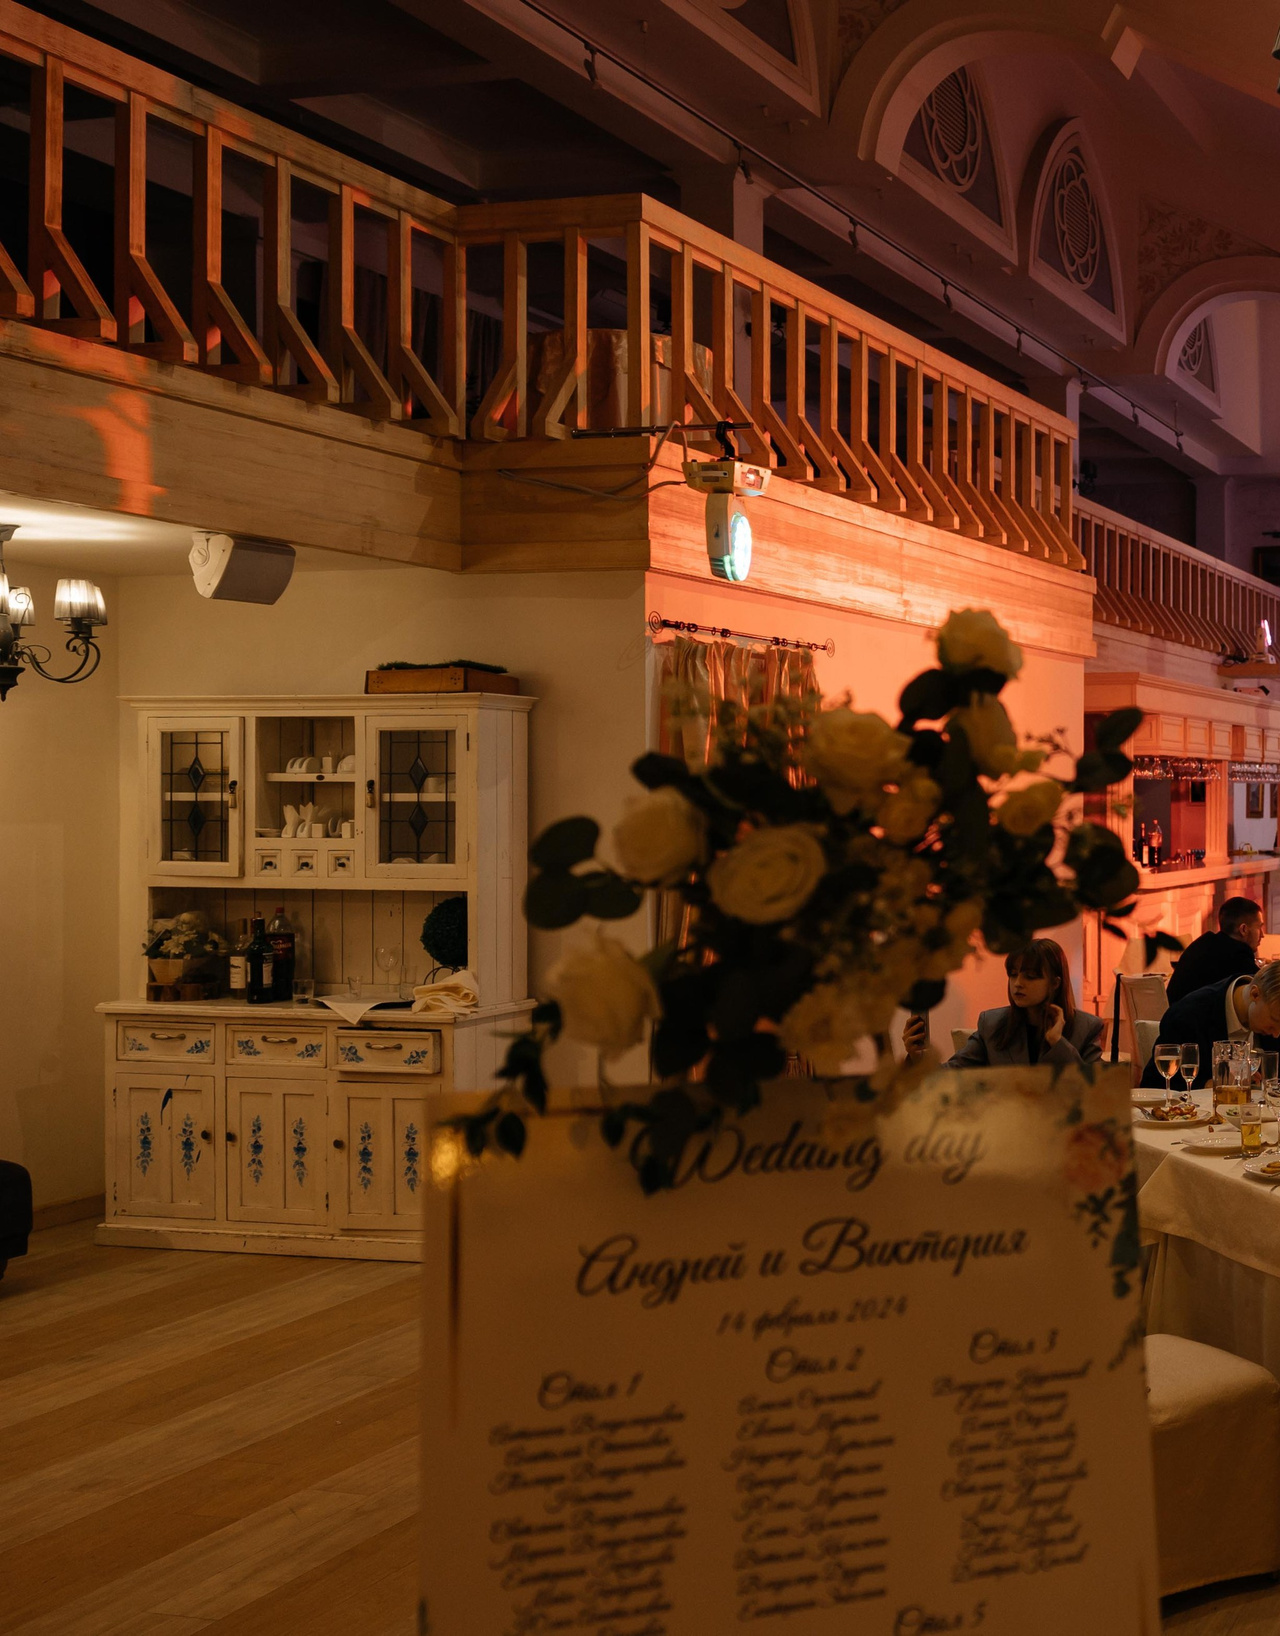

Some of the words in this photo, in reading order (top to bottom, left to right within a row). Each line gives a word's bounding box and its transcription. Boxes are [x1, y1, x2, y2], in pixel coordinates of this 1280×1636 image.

[904, 1112, 986, 1187] day
[576, 1232, 748, 1308] Андрей
[758, 1248, 787, 1280] и
[798, 1217, 1029, 1277] Виктория
